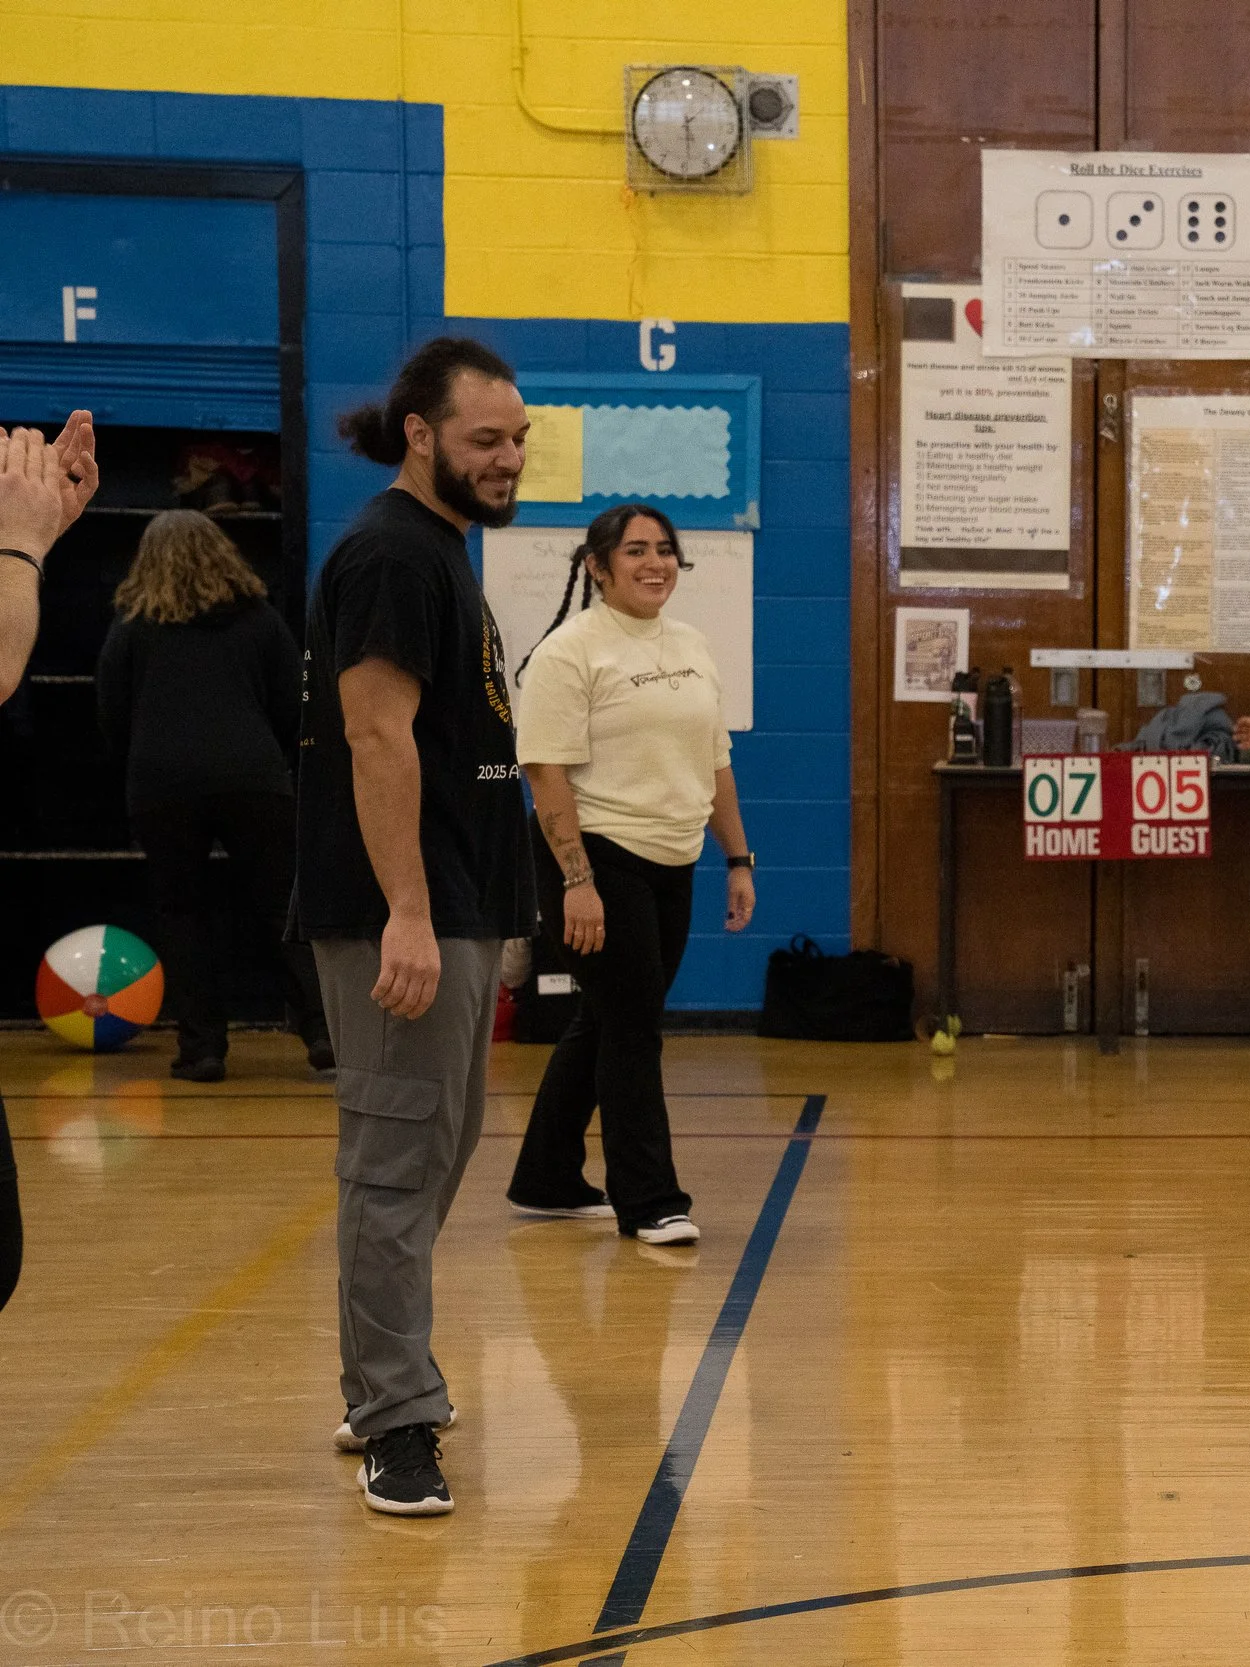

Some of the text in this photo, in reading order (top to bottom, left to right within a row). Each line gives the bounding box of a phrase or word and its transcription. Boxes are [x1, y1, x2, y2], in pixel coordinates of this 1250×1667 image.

[1070, 163, 1203, 178] Roll the Dice Exercises
[62, 286, 98, 343] F
[640, 318, 677, 372] G
[930, 363, 958, 371] disease
[961, 363, 974, 371] and
[940, 388, 954, 397] yet
[956, 387, 964, 395] it
[966, 388, 972, 396] is
[974, 388, 994, 397] 80%
[925, 410, 1048, 423] Heart disease prevention
[1203, 408, 1217, 416] The
[916, 440, 928, 448] Be
[930, 441, 971, 450] proactive
[974, 442, 993, 450] with
[994, 443, 1015, 453] your
[1017, 442, 1043, 451] health
[926, 451, 954, 461] Eating
[965, 452, 996, 462] healthy
[926, 462, 974, 472] Maintaining
[983, 463, 1013, 473] healthy
[1016, 463, 1043, 473] weight
[926, 473, 970, 483] Exercising
[972, 474, 1008, 484] regularly
[926, 483, 941, 491] Not
[943, 483, 978, 494] smoking
[926, 493, 966, 503] Reducing
[926, 504, 968, 514] Managing
[969, 505, 987, 514] your
[946, 536, 971, 545] healthy
[477, 765, 507, 781] 2025
[1028, 769, 1205, 817] 07 05
